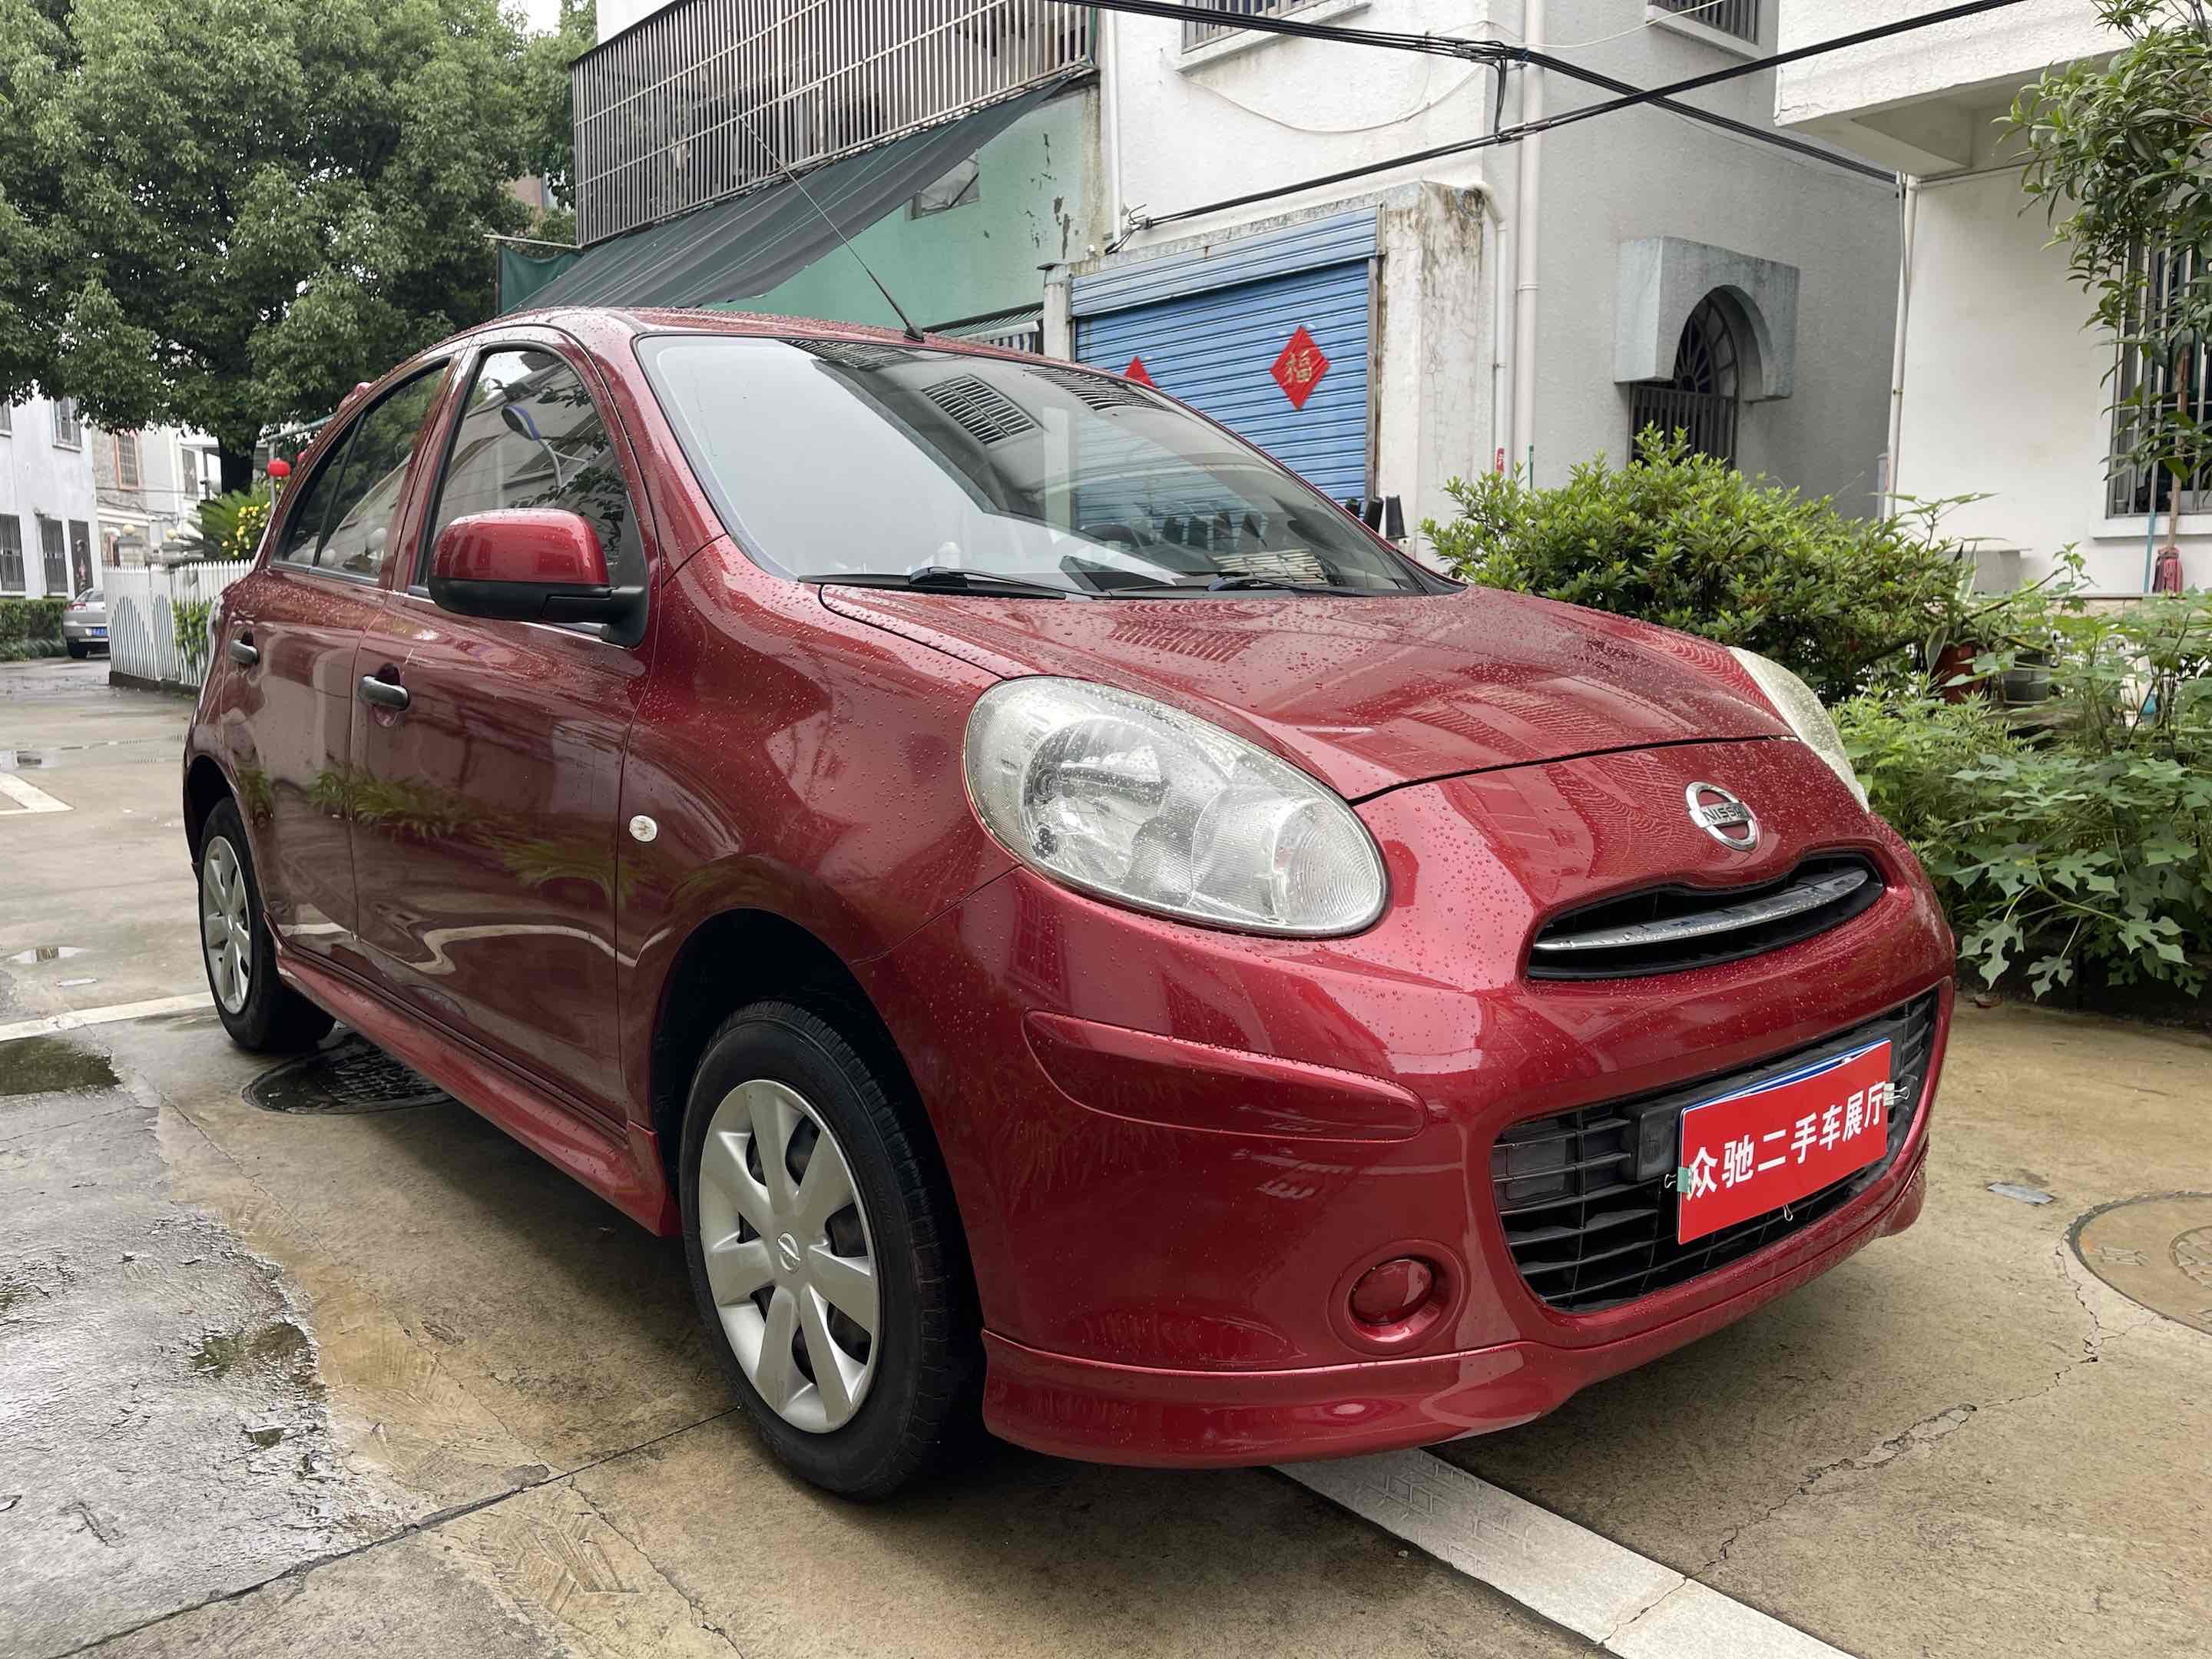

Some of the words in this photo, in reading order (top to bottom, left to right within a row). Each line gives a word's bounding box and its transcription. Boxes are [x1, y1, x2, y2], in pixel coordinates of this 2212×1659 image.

[1284, 349, 1312, 384] 福
[1703, 802, 1750, 823] NISS
[1687, 1081, 1886, 1200] 众驰二手车展厅
